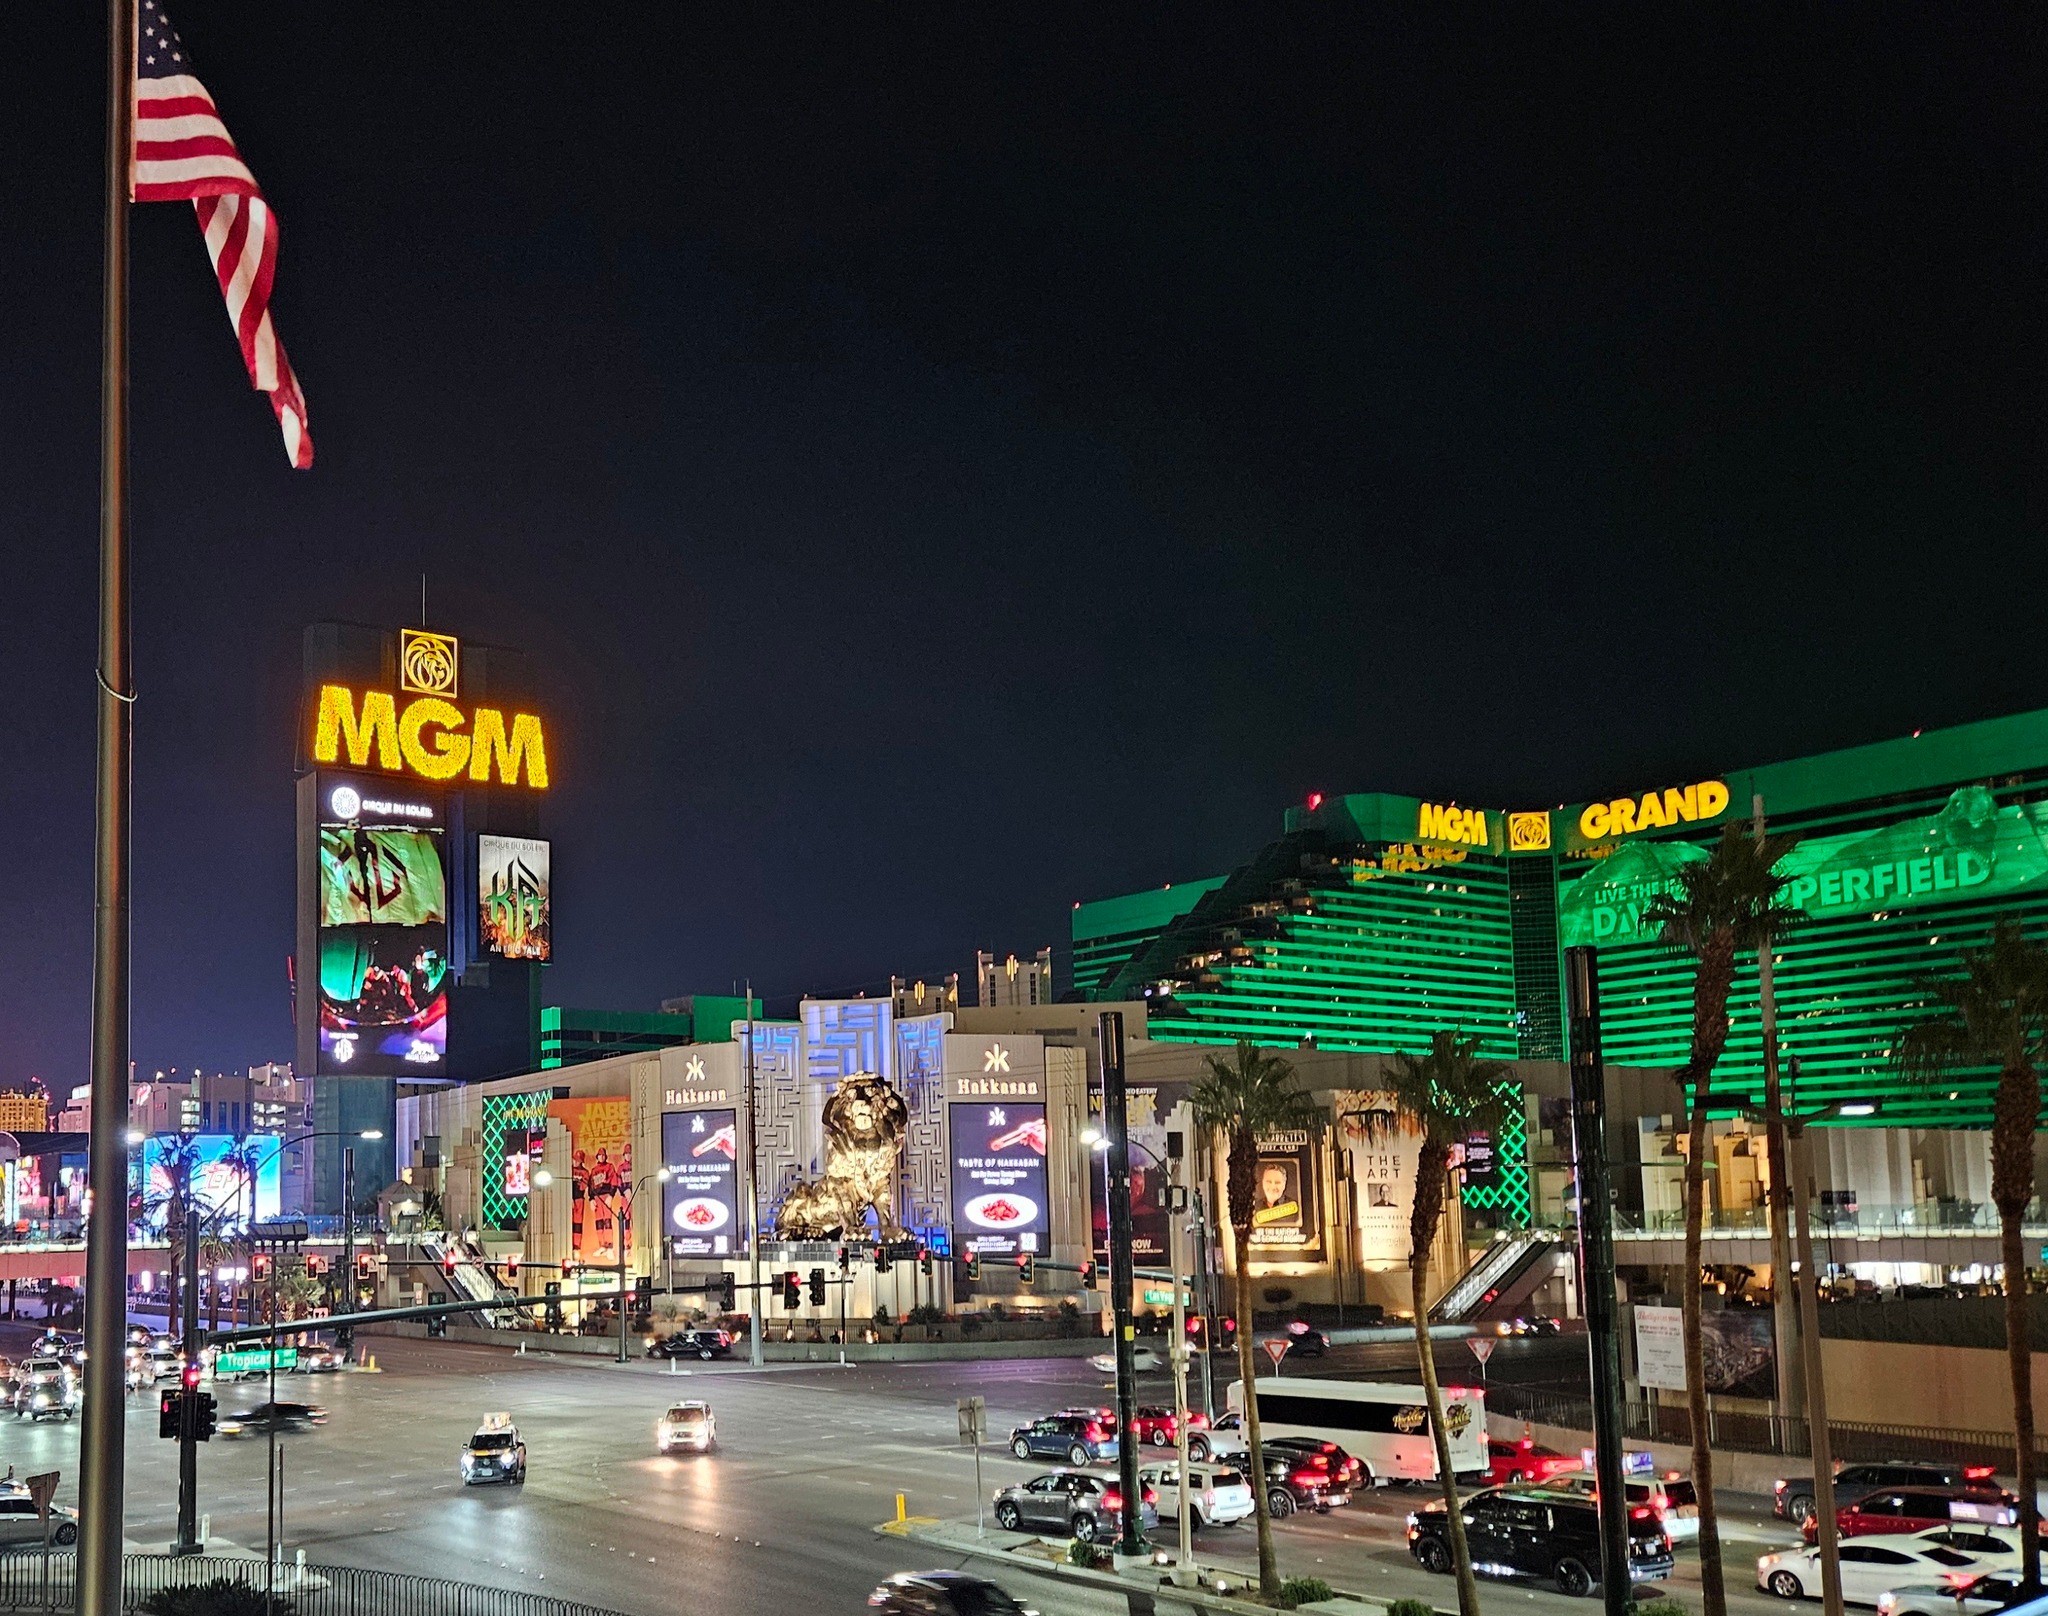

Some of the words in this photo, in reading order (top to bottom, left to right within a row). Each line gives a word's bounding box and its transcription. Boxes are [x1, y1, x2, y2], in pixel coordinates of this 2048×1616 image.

[315, 685, 548, 788] MGM
[1580, 780, 1730, 839] GRAND
[1419, 802, 1488, 847] MGM
[483, 839, 509, 851] CIRQUE
[511, 841, 521, 849] DU
[1594, 886, 1627, 904] LIVE
[1630, 881, 1660, 899] THE
[489, 944, 502, 953] AN
[665, 1087, 727, 1105] Hakkasan
[957, 1078, 1038, 1096] Hakkasan
[958, 1158, 983, 1168] TASTE
[984, 1158, 996, 1168] OF
[997, 1158, 1040, 1168] HAKKASAN
[1367, 1155, 1401, 1166] THE
[1367, 1168, 1401, 1179] ART
